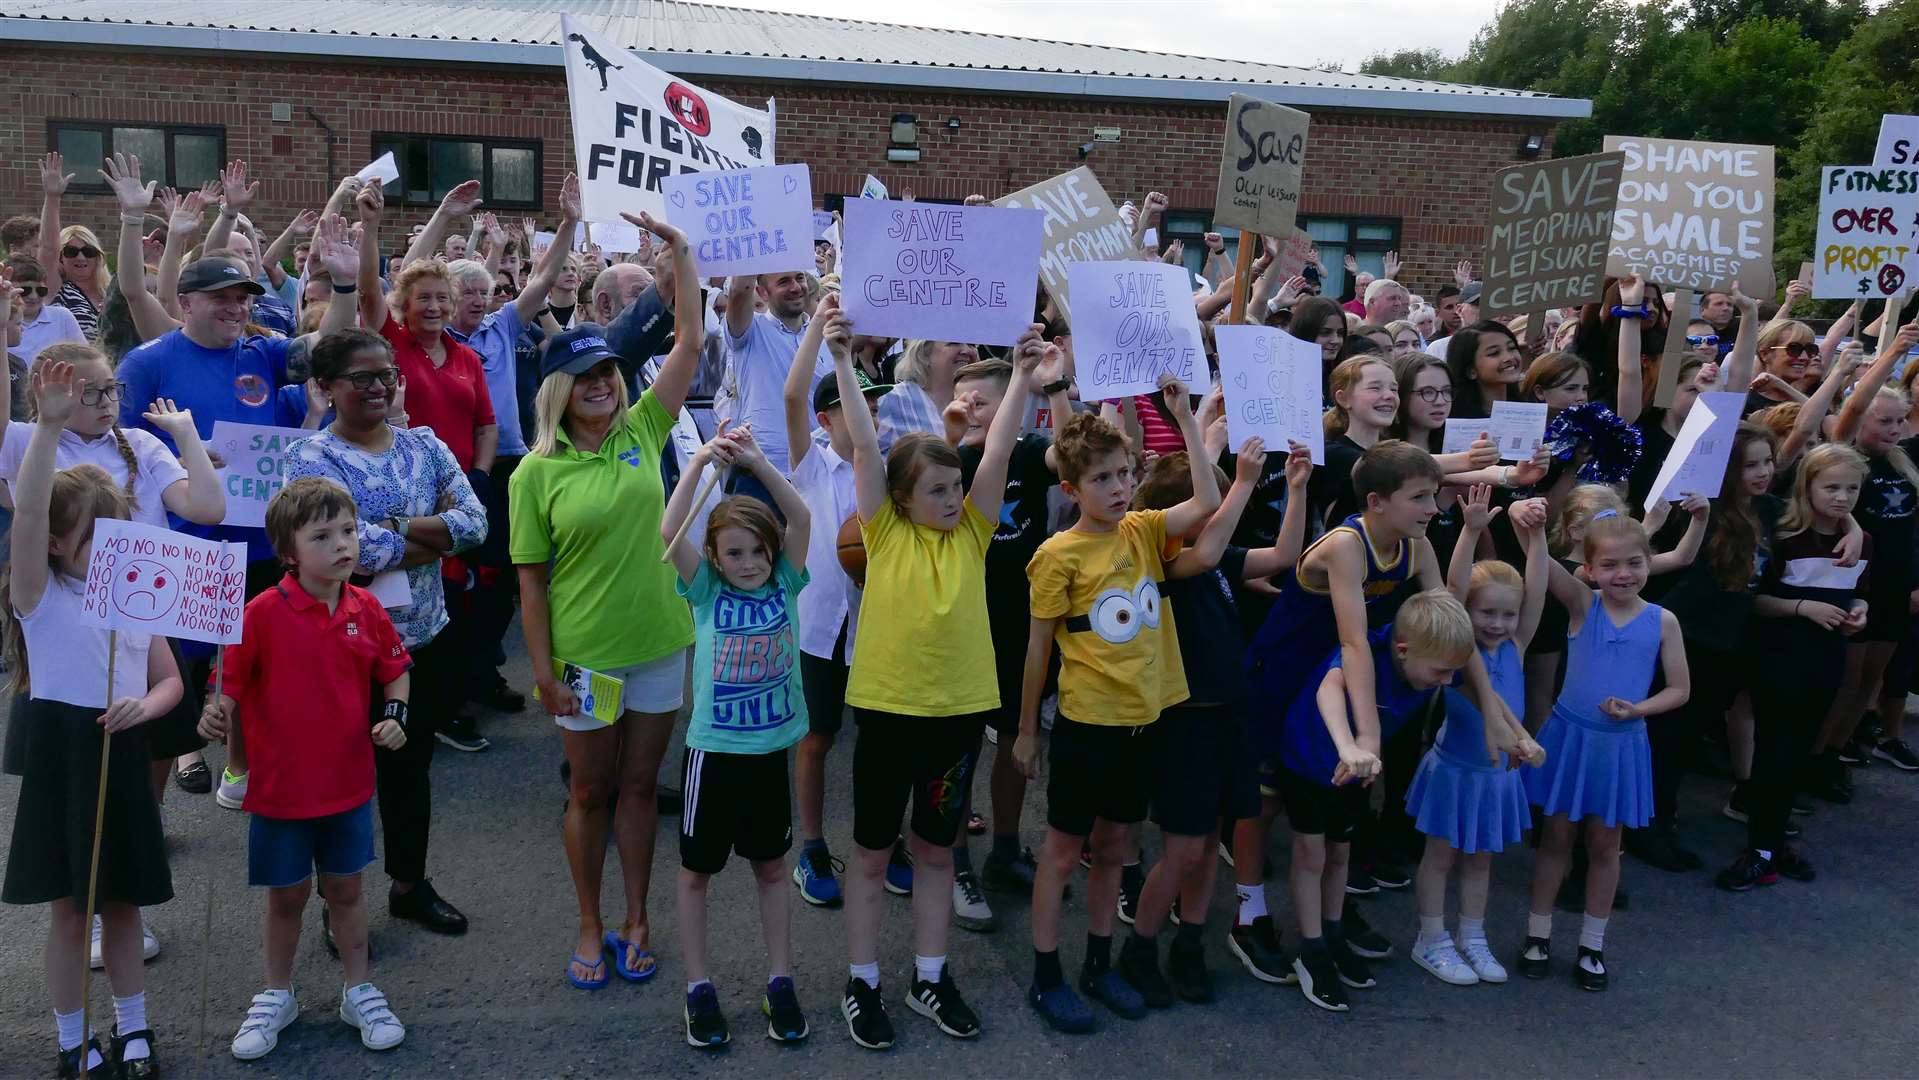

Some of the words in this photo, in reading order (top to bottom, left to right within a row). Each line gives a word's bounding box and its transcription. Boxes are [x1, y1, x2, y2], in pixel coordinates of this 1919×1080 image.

[1236, 101, 1303, 172] Save
[588, 143, 671, 194] FOR
[1618, 142, 1760, 177] SHAME
[695, 174, 754, 208] SAVE
[1498, 159, 1620, 215] SAVE
[1617, 180, 1669, 203] ON
[1685, 181, 1763, 215] YOU
[1828, 168, 1919, 194] FITNESS
[705, 205, 757, 235] OUR
[1006, 174, 1100, 237] AVE
[1832, 206, 1898, 236] OVER
[888, 208, 964, 242] SAVE
[1491, 210, 1614, 251] MEOPHAM
[1611, 208, 1763, 260] SWALE
[698, 229, 788, 262] CENTRE
[897, 247, 965, 276] OUR
[1490, 241, 1607, 279] LEISURE
[1608, 246, 1741, 275] ACADEMIES
[1824, 244, 1910, 275] PROFIT
[864, 275, 1007, 308] CENTRE
[1110, 272, 1167, 309] SAVE
[1488, 273, 1597, 309] CENTRE
[1625, 263, 1724, 288] TRUST
[1115, 311, 1174, 348] OUR
[1093, 348, 1195, 386] CENTRE
[93, 550, 116, 567] NO
[105, 537, 129, 554] NO
[133, 539, 155, 555] NO
[162, 543, 179, 558] NO
[184, 546, 201, 563] NO
[205, 550, 235, 570] NO
[87, 582, 108, 601] NO
[89, 566, 111, 584] NO
[85, 599, 107, 618] NO
